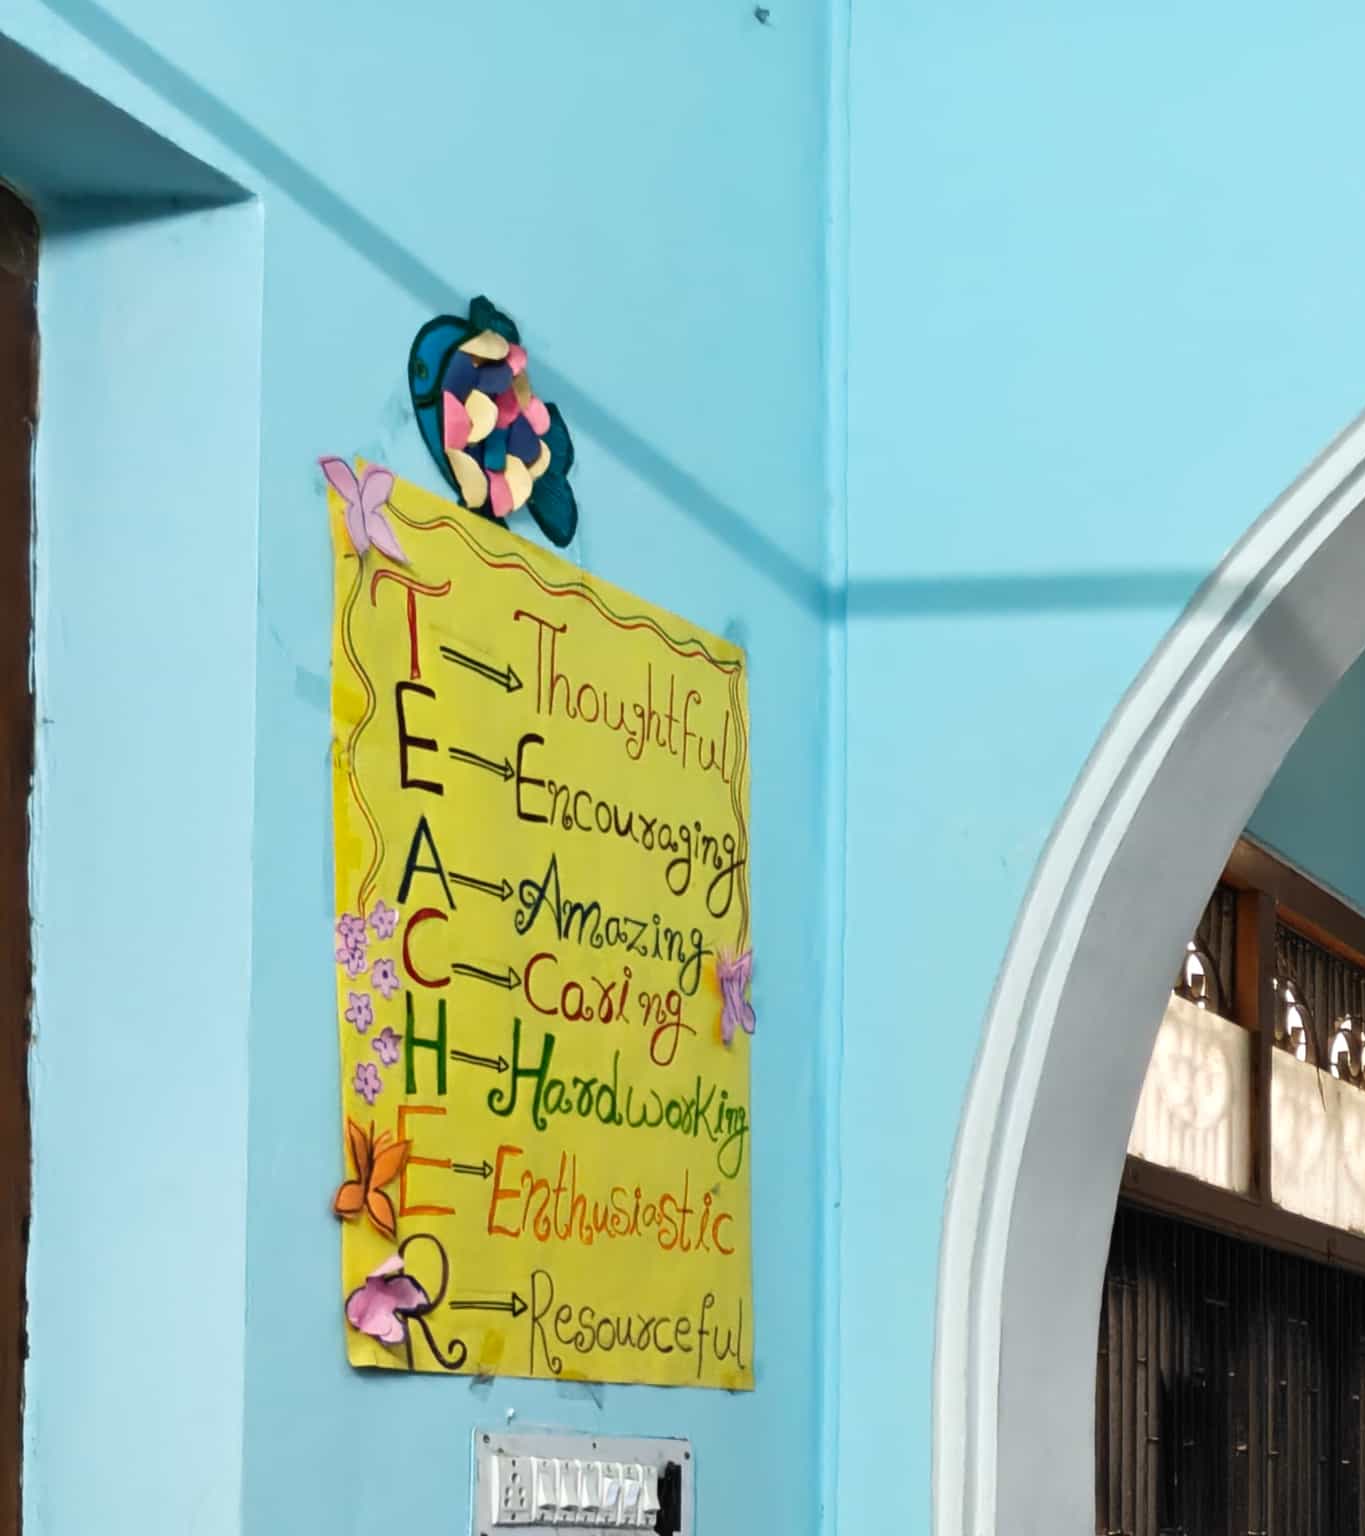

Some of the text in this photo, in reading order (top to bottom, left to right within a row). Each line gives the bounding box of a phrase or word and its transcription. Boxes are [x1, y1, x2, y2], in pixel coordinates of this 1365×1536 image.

[513, 609, 730, 783] Thoughtful
[515, 733, 744, 919] Encouraging
[514, 853, 713, 996] Amazing
[523, 952, 696, 1066] Caring
[487, 1017, 748, 1180] Hardworking
[488, 1145, 735, 1255] Enthusiastic
[528, 1269, 745, 1378] Resourceful
